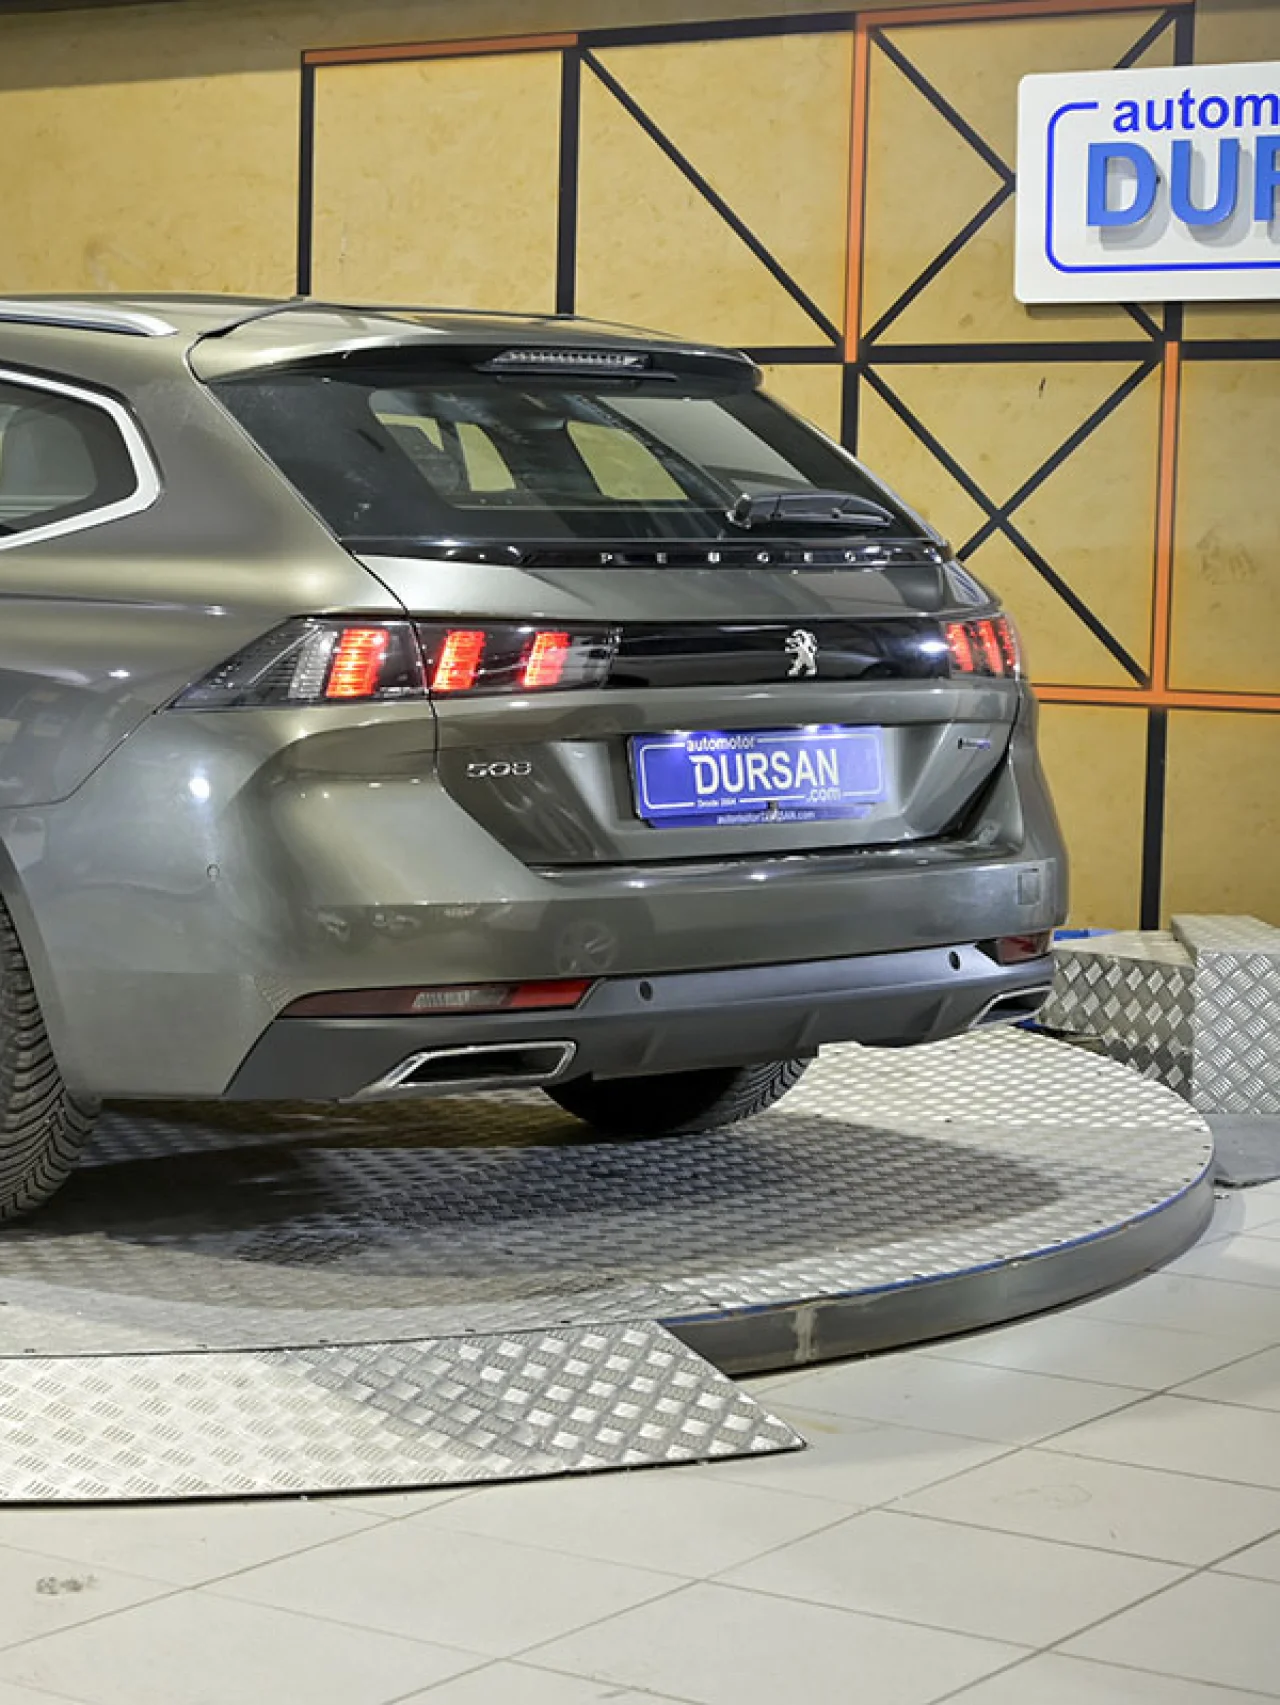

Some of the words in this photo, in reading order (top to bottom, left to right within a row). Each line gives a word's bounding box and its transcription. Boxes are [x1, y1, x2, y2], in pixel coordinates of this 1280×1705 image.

[686, 735, 756, 752] automotor
[466, 761, 532, 778] 508
[689, 748, 840, 796] DURSAN
